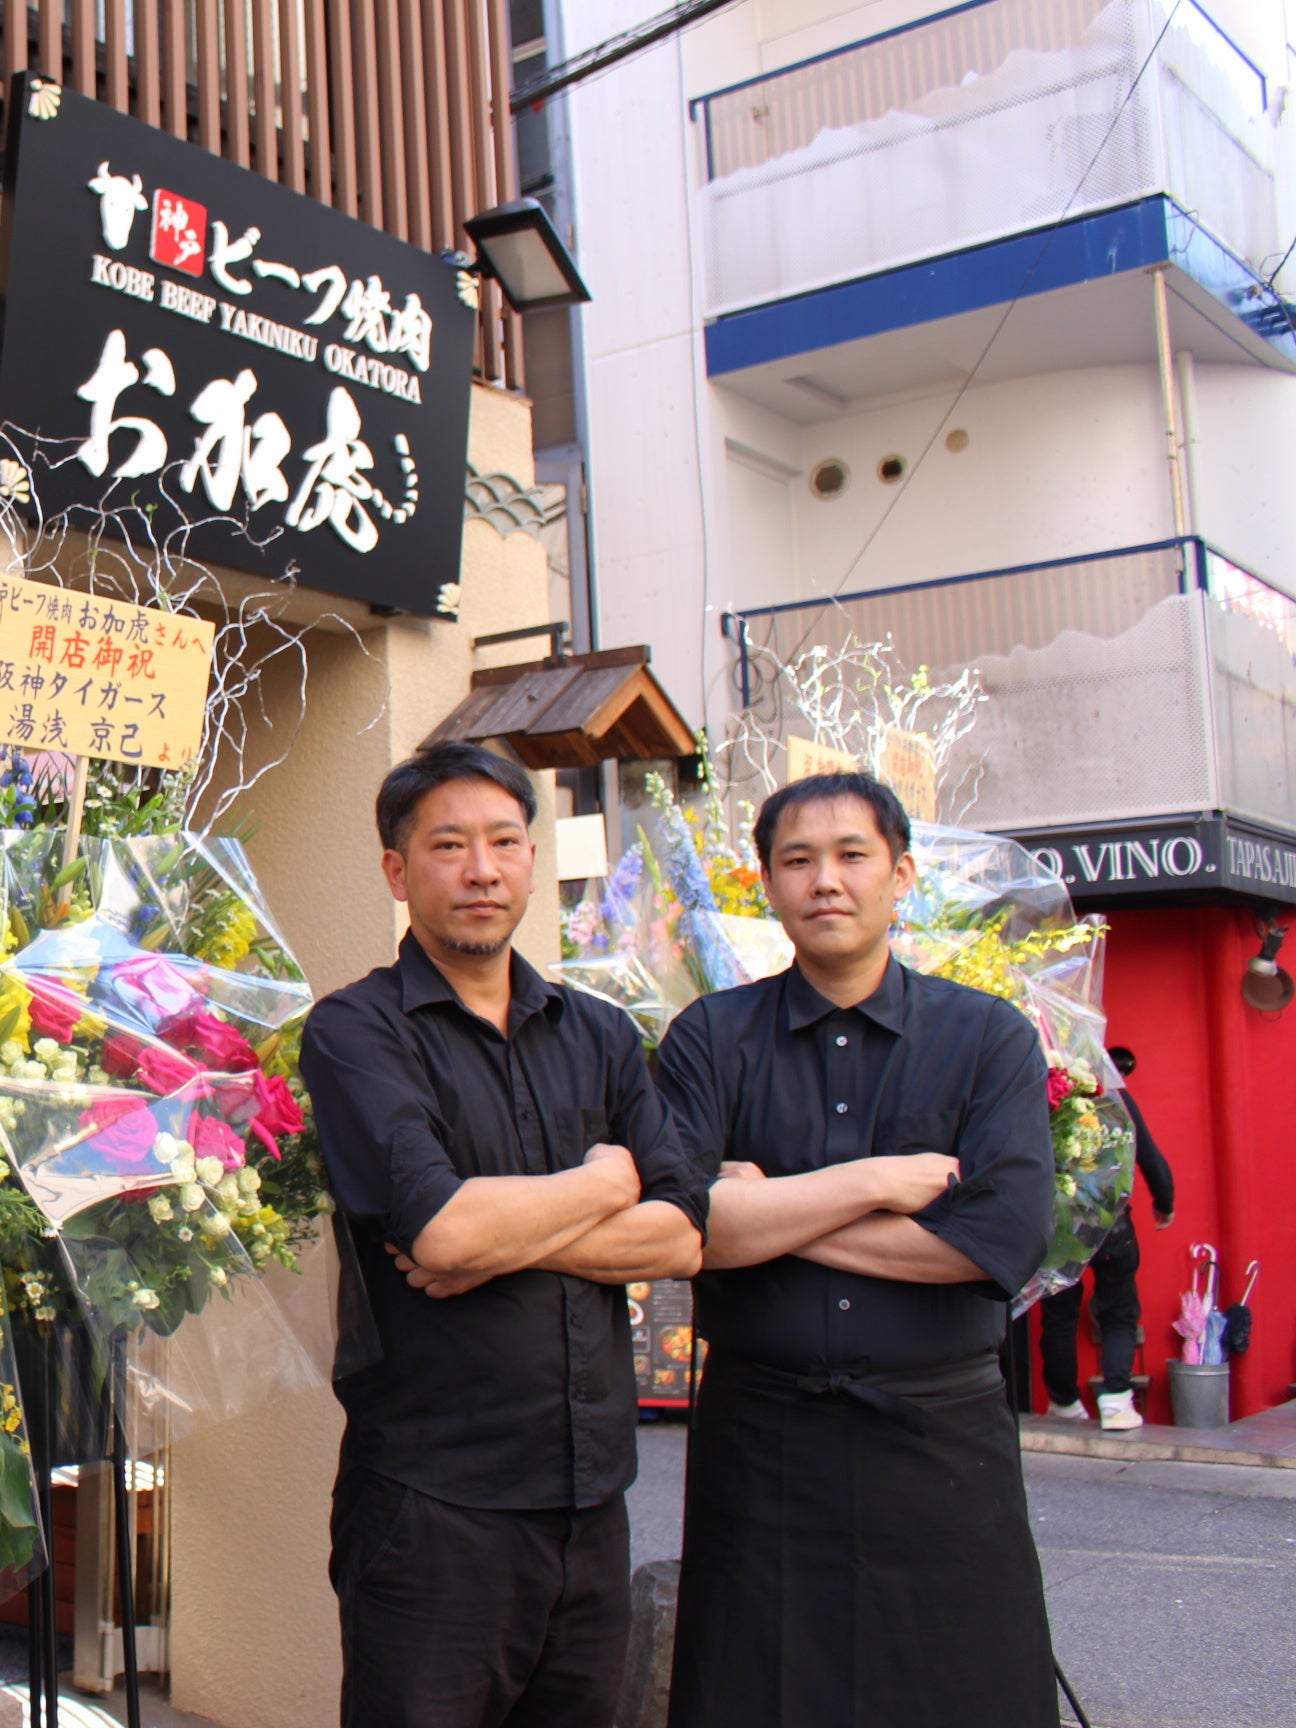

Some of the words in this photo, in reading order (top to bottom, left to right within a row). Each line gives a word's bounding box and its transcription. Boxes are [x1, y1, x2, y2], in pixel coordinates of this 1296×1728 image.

[90, 254, 155, 302] KOBE
[159, 279, 217, 324] BEEF
[219, 301, 319, 363] YAKINIKU
[323, 343, 422, 405] OKATORA
[159, 198, 202, 266] 神戸
[208, 219, 433, 373] ビーフ焼肉
[76, 328, 419, 553] お加虎
[29, 625, 156, 680] 開店御祝
